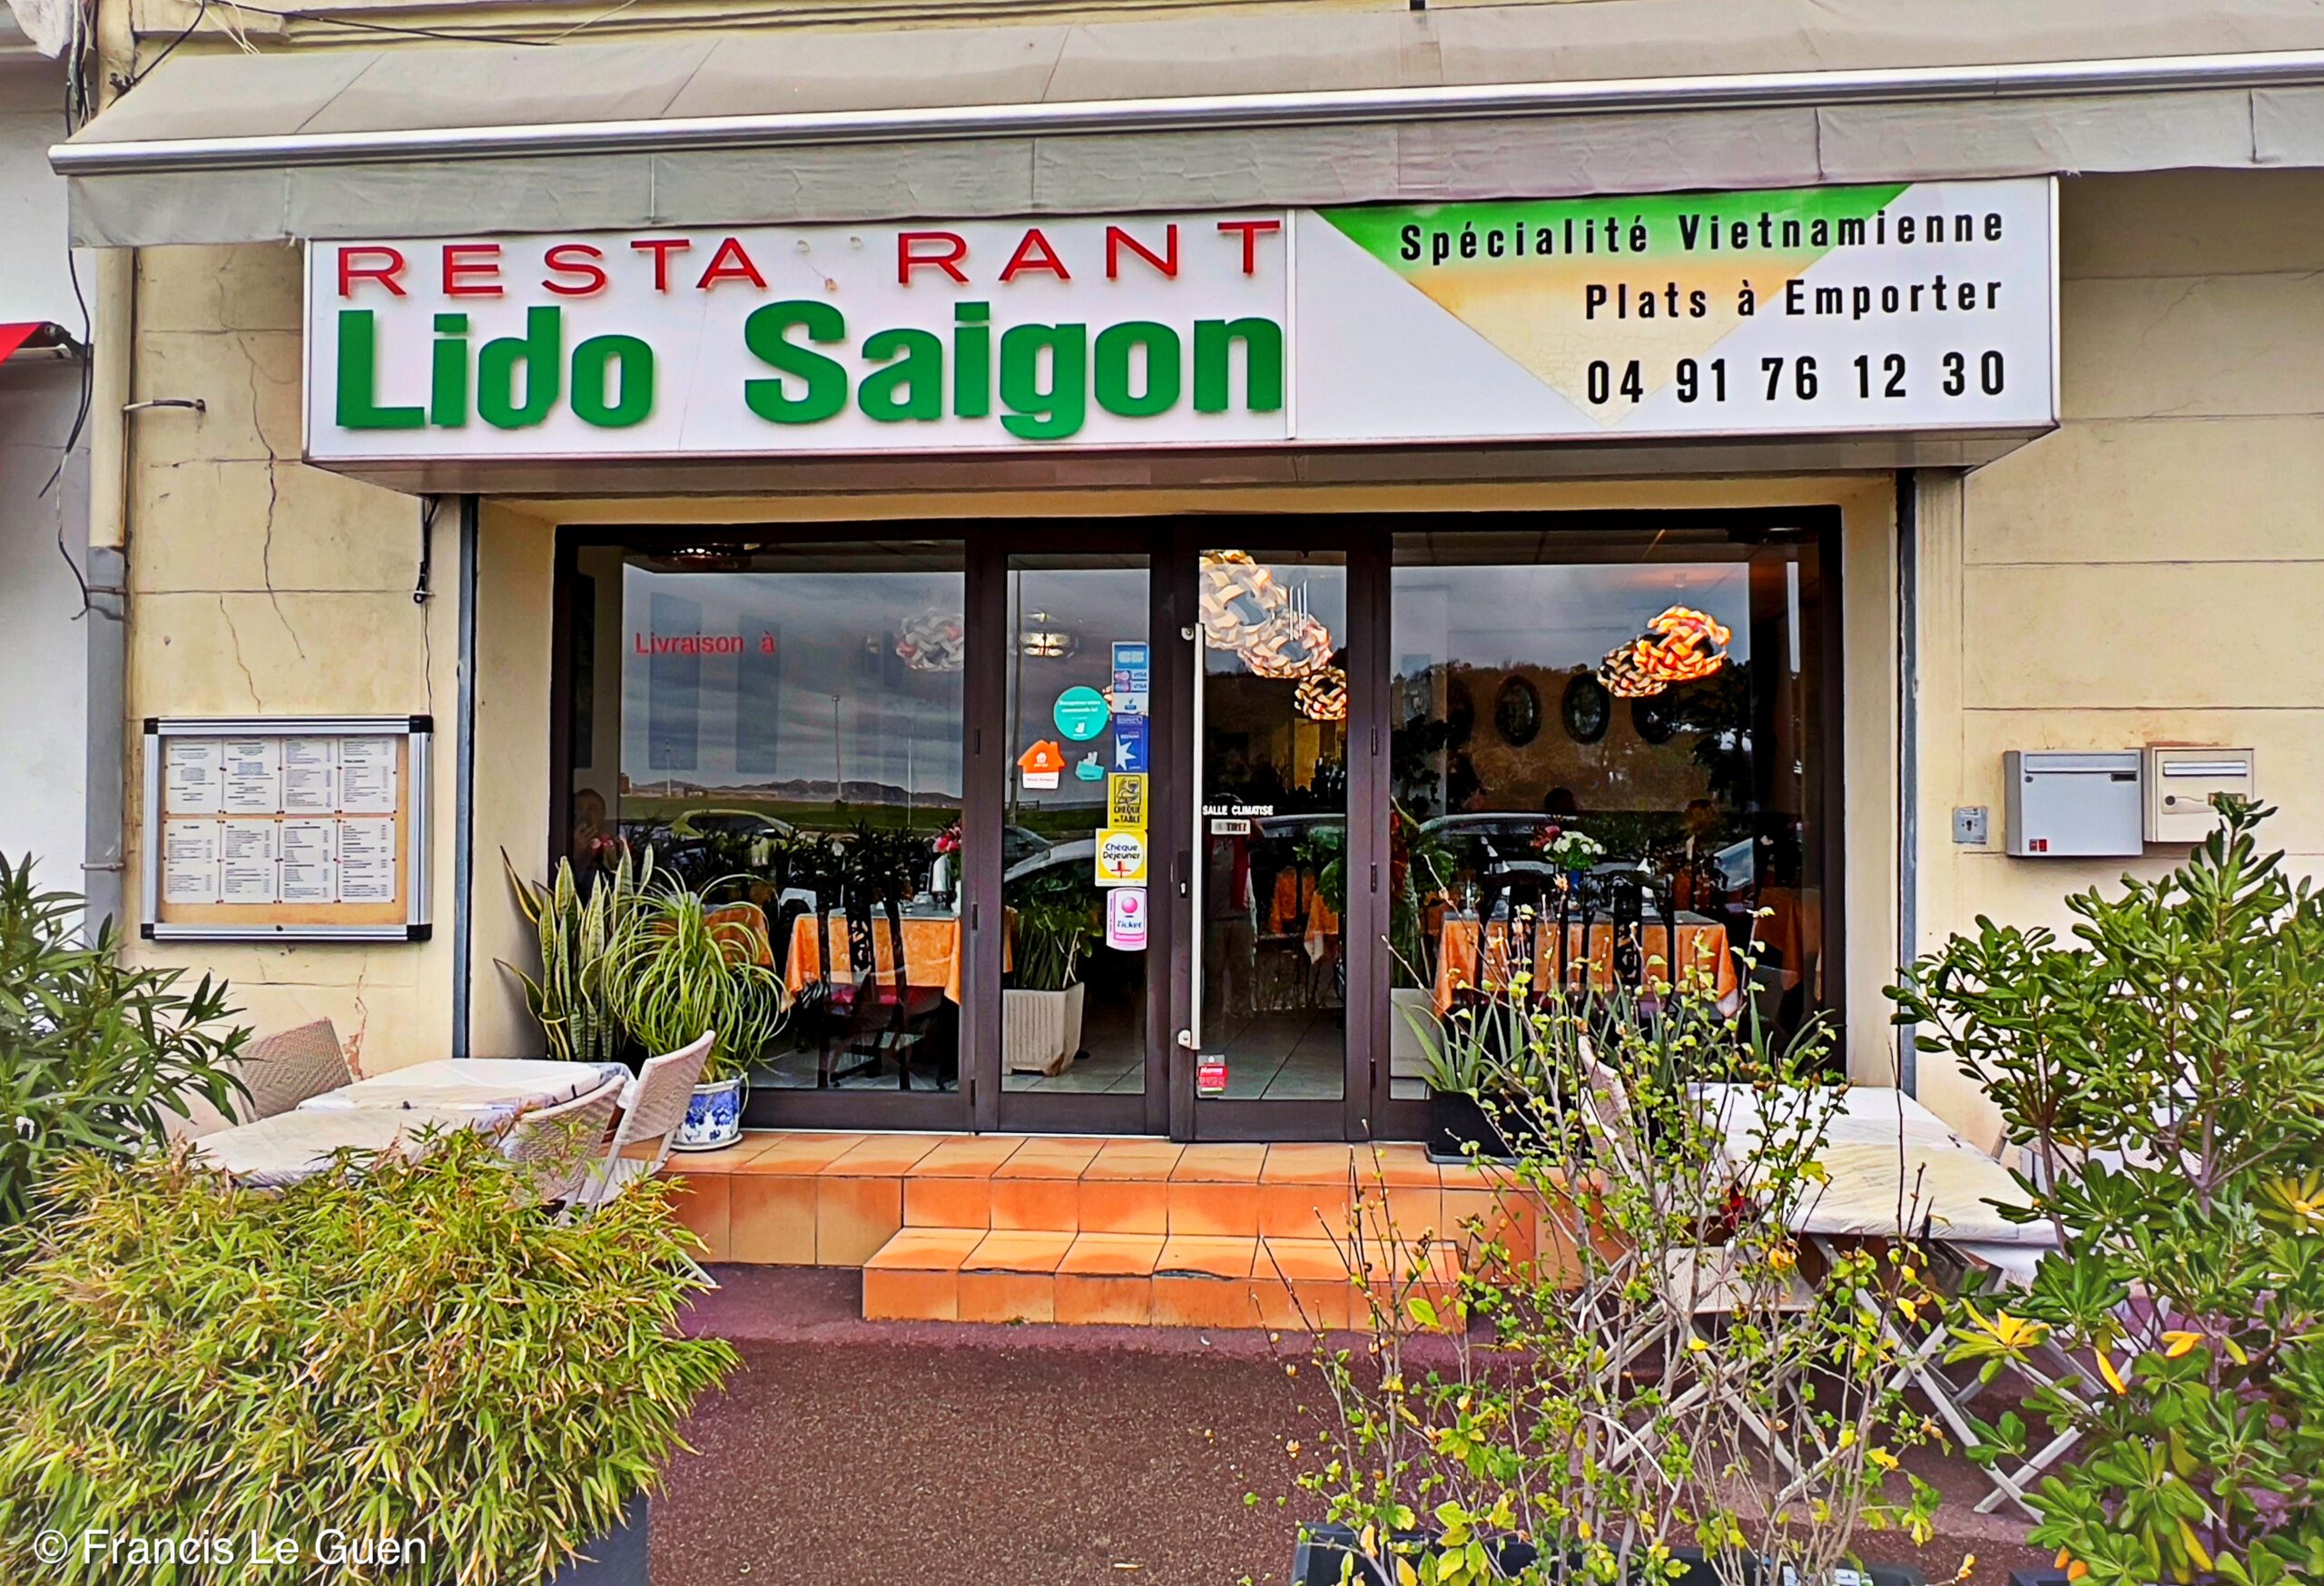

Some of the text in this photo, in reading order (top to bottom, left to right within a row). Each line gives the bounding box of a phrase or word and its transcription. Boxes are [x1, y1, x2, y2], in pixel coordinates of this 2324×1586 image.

[1401, 209, 2004, 267] Spécialité Vietnamienne
[1585, 274, 2003, 321] Plats à Emporter
[336, 301, 1284, 442] Lido Saigon
[1587, 350, 2005, 406] 04 91 76 12 30
[635, 631, 776, 655] Livraison à
[1119, 814, 1141, 823] TABLE
[1202, 804, 1228, 816] SALLE
[1117, 920, 1142, 929] Ticket
